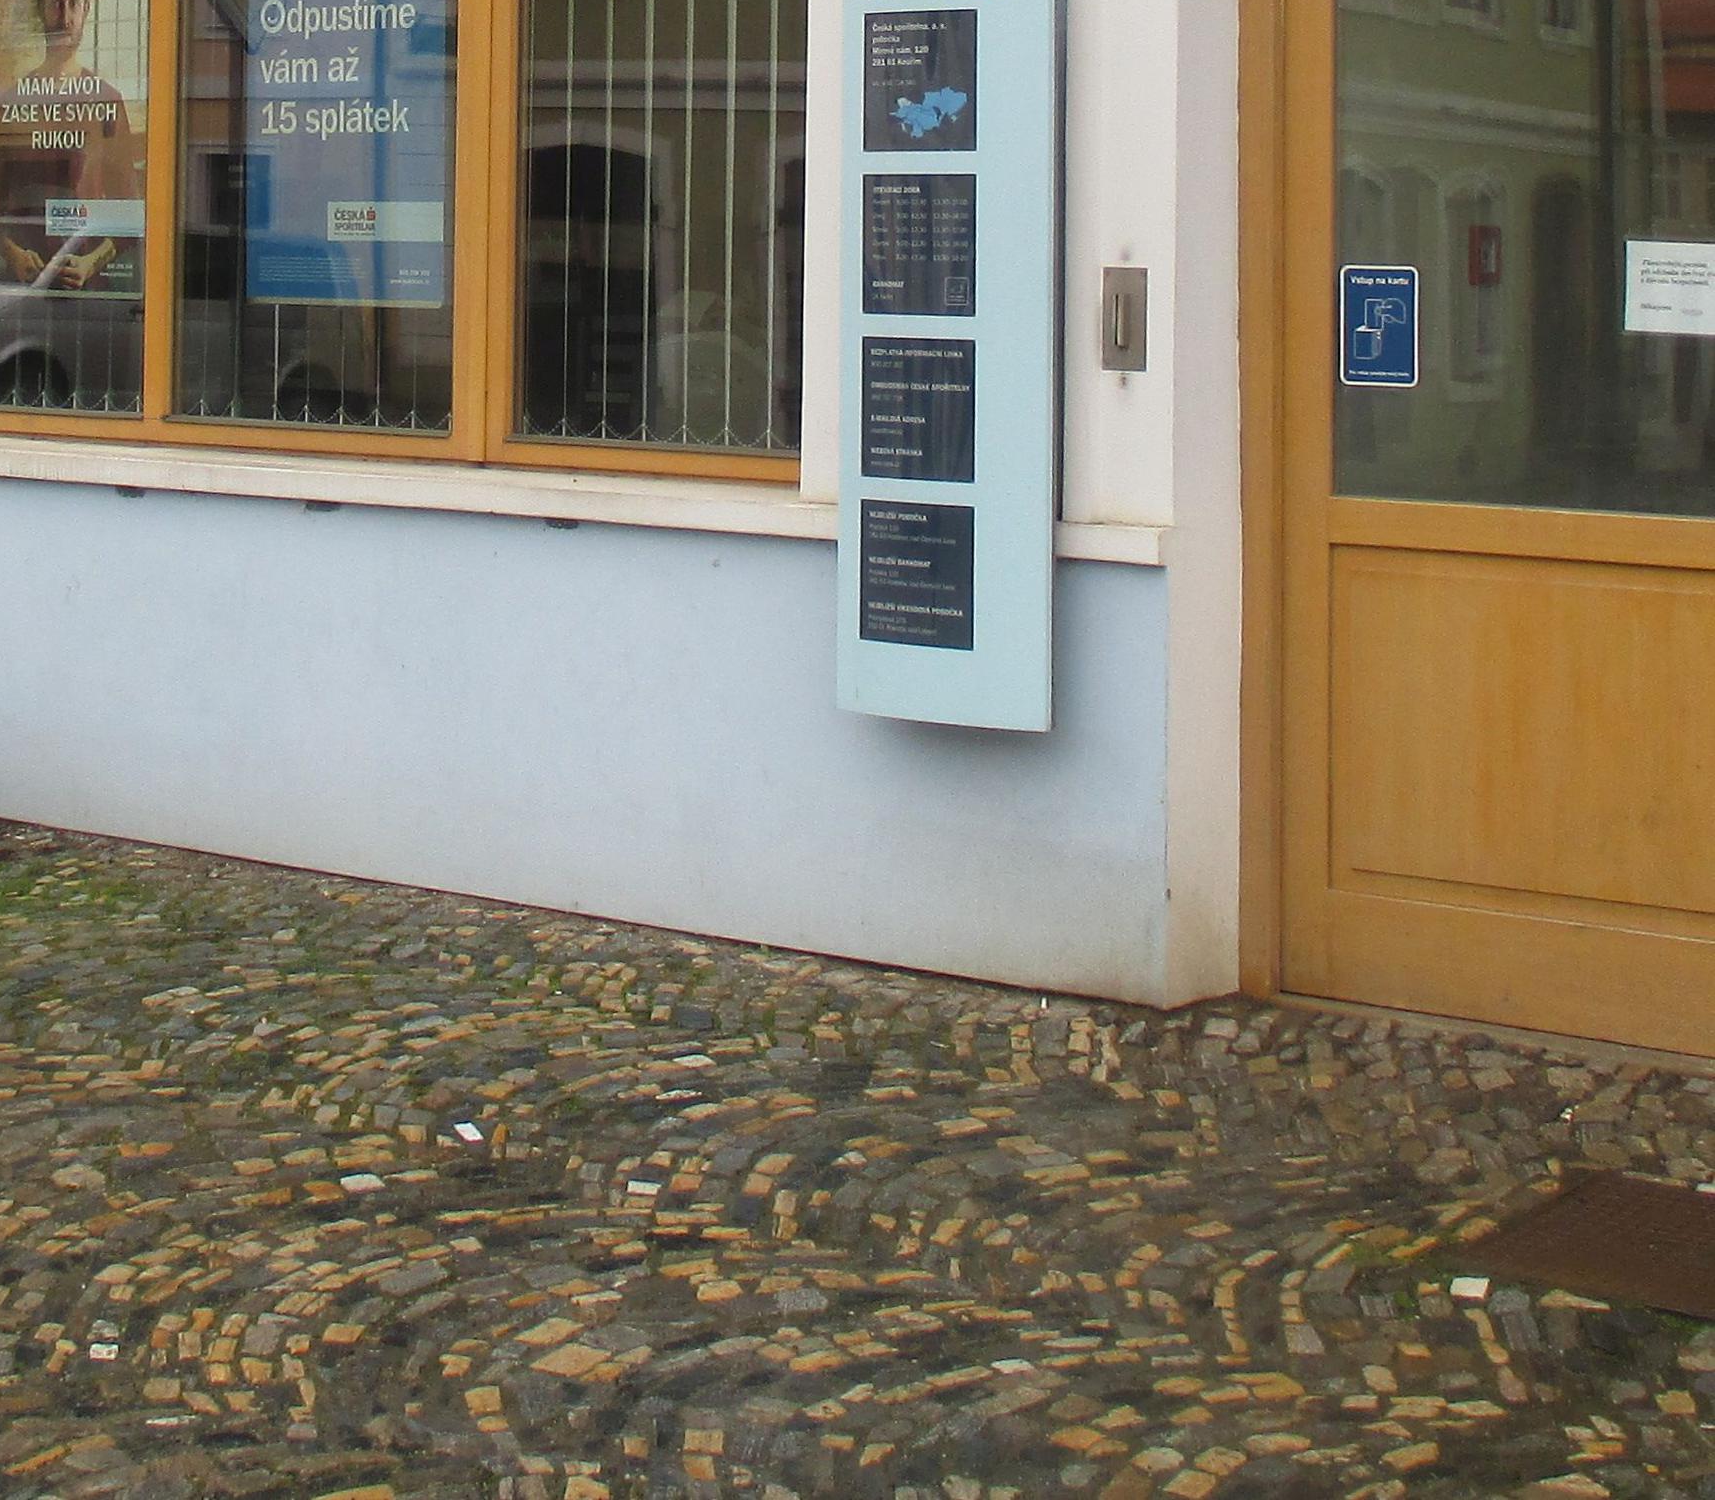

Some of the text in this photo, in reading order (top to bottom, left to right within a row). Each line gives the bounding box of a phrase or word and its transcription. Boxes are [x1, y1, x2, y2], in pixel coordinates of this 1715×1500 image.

[260, 46, 360, 84] vám až
[58, 71, 102, 95] ŽIVOT
[1, 104, 38, 123] ZASE
[43, 103, 62, 122] VE
[261, 98, 410, 141] 15 splátek
[32, 130, 85, 150] RUKOU
[334, 207, 366, 221] ČESKÁ
[1349, 275, 1374, 286] Vstup
